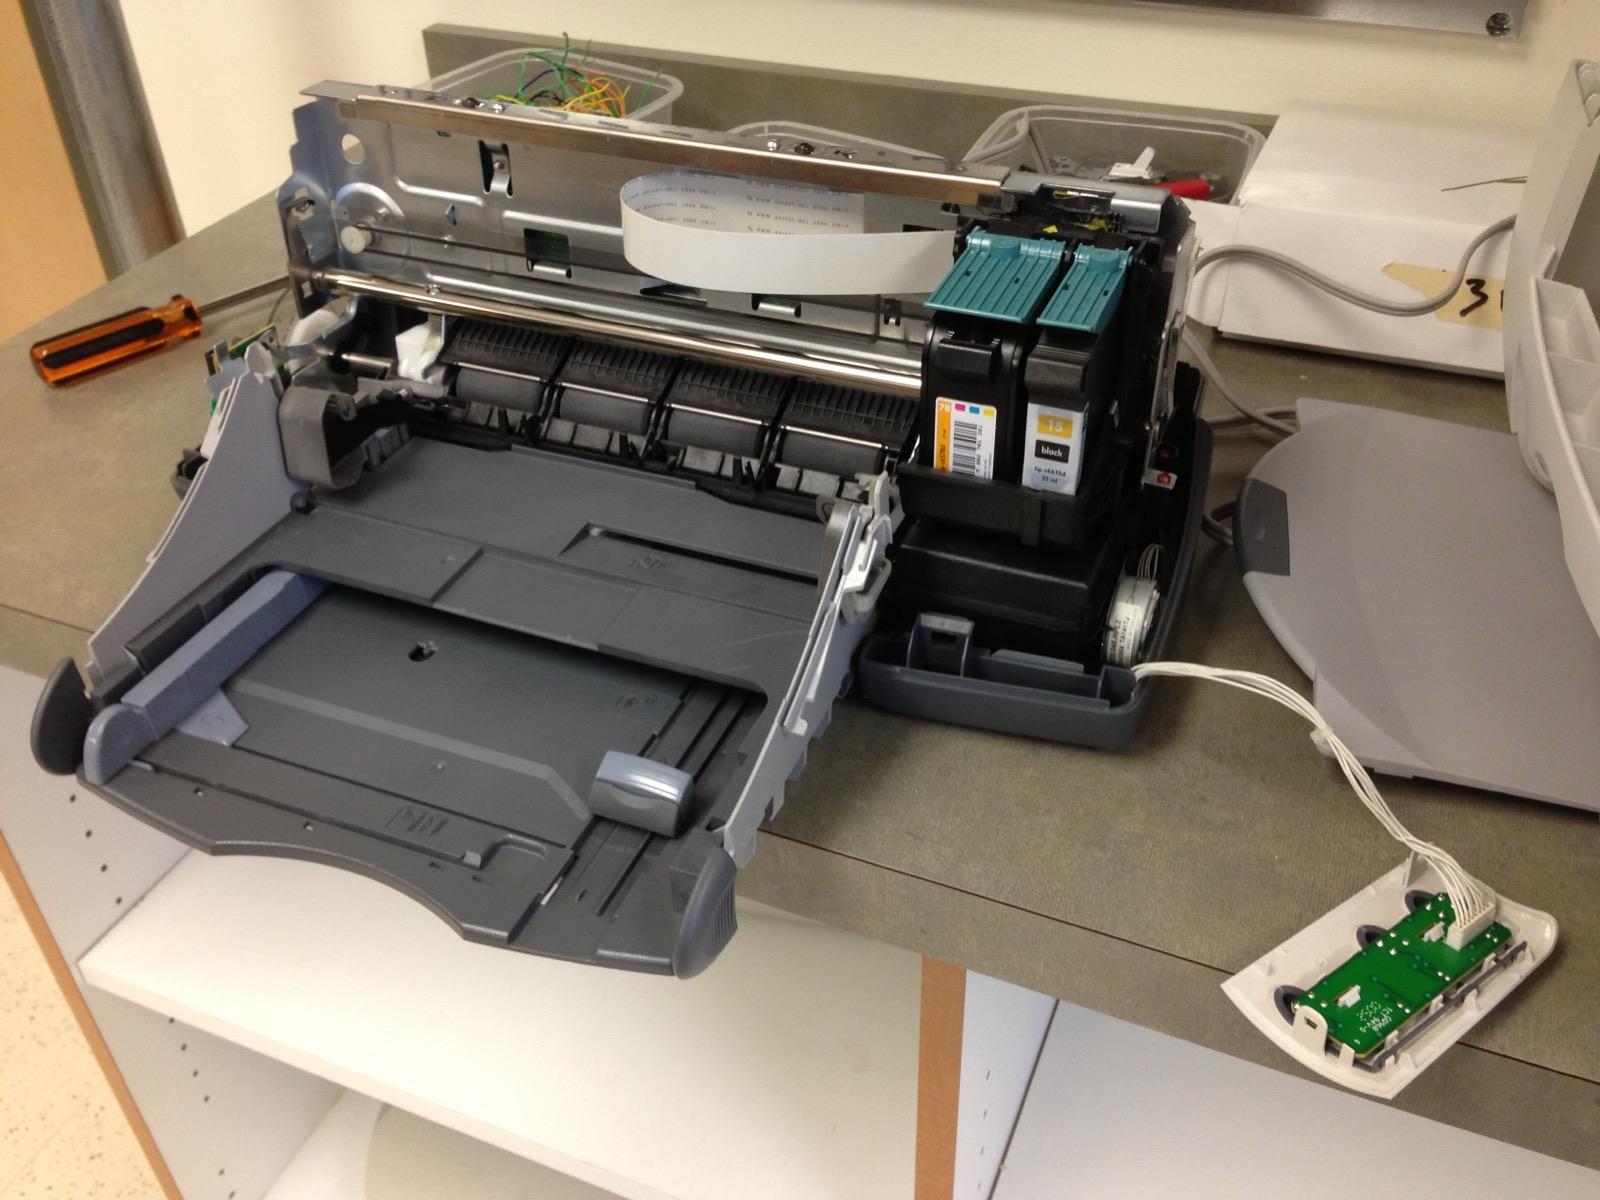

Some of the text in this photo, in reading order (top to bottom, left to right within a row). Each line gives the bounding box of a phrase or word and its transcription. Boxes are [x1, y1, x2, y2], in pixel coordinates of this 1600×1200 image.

[1459, 278, 1504, 317] 3
[939, 402, 951, 413] 78
[1047, 420, 1064, 433] 15
[1041, 445, 1063, 458] black
